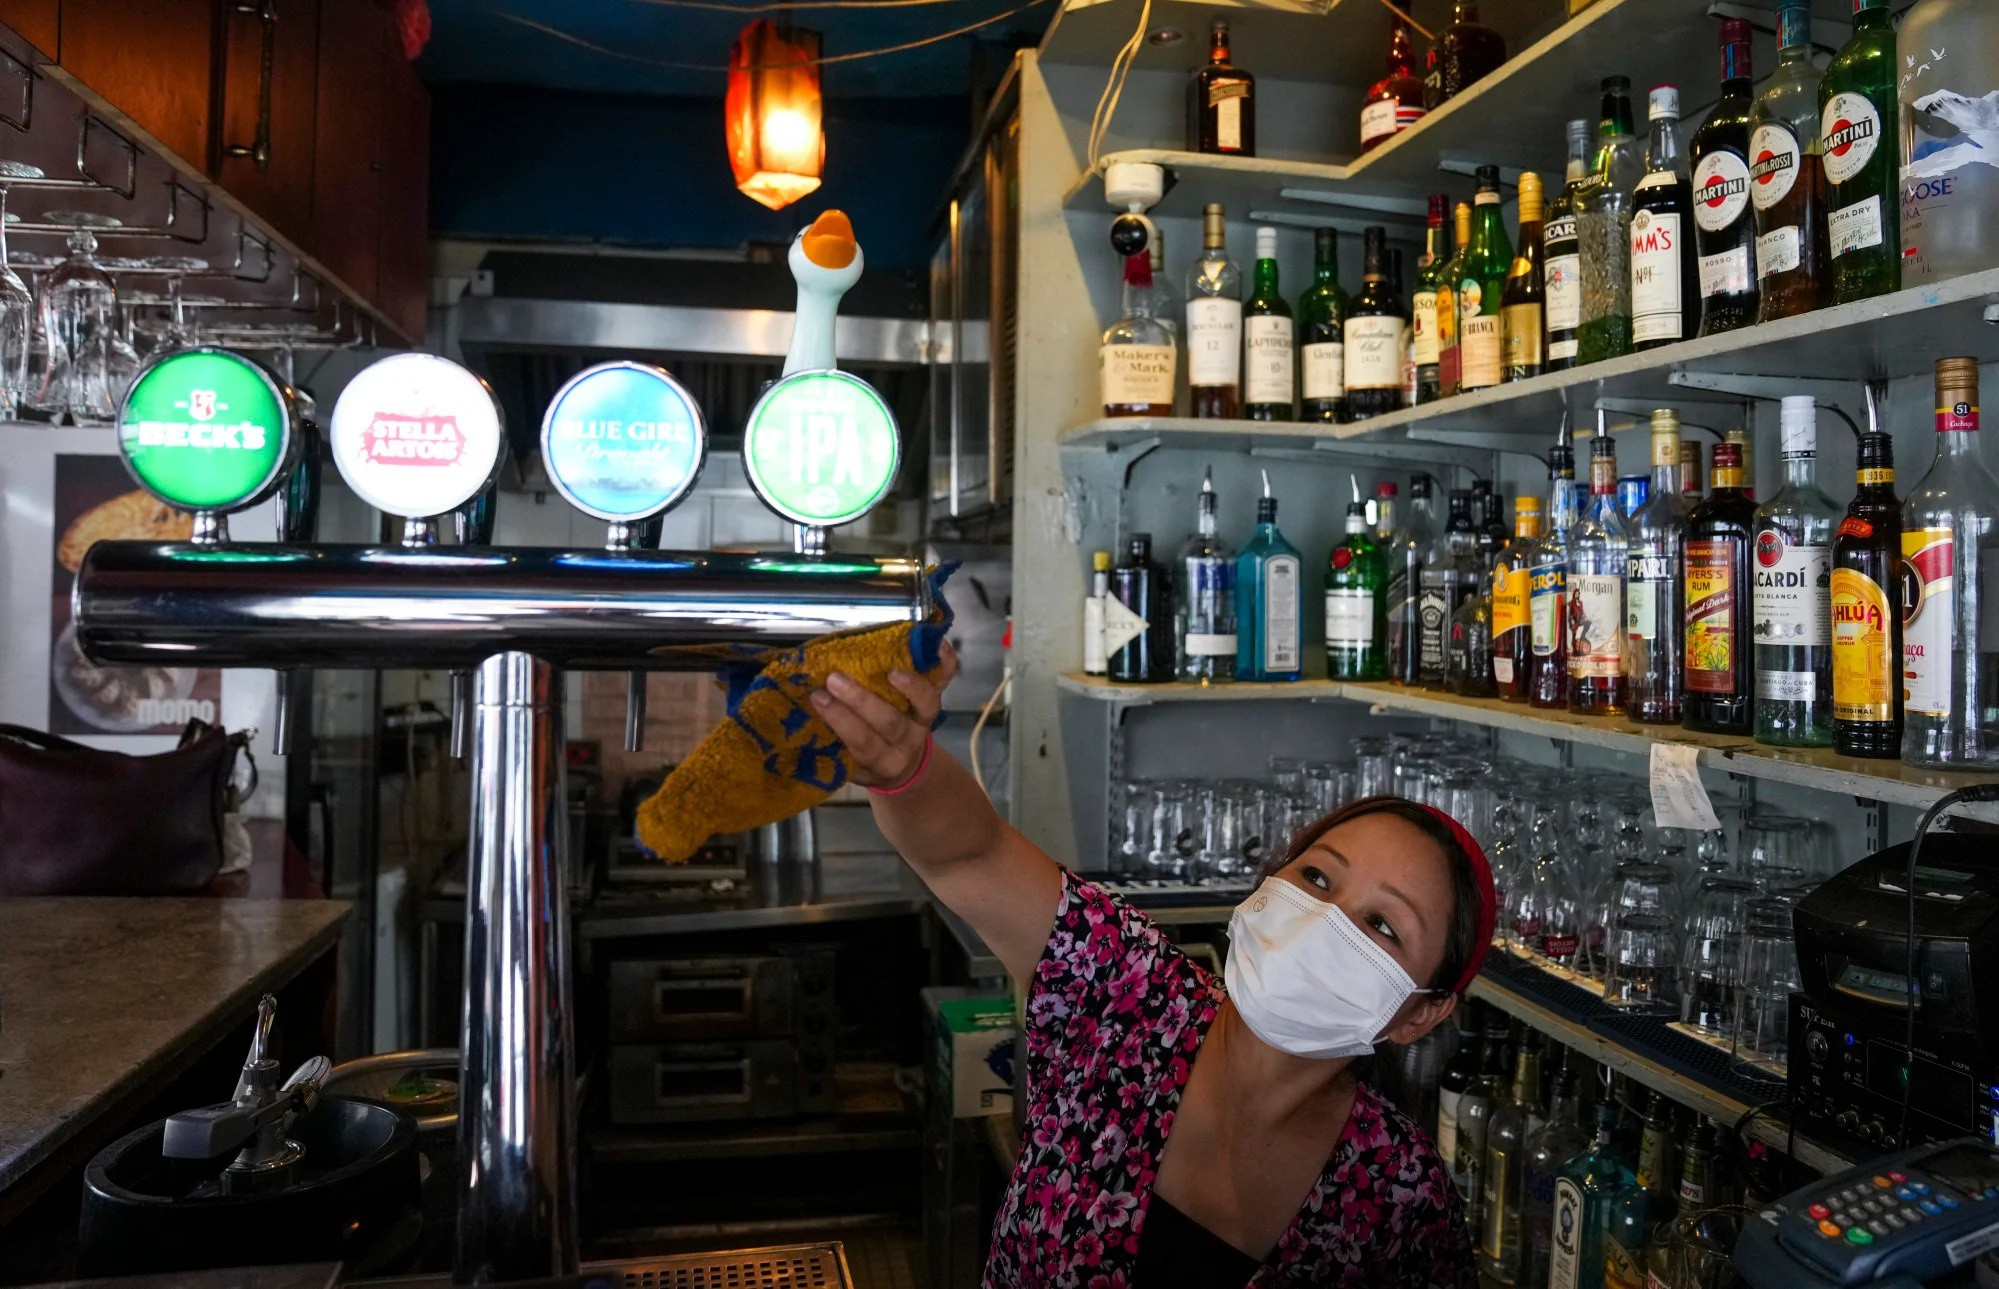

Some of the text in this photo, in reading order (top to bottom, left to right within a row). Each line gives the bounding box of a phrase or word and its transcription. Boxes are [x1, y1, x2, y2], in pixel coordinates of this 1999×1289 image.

[1824, 120, 1872, 152] MARTINI
[1696, 179, 1743, 203] MARTINI
[1830, 206, 1871, 226] EXTRA DRY
[1545, 223, 1576, 241] ICAR
[1705, 257, 1731, 267] ROSSO
[1207, 340, 1219, 350] 12
[1114, 351, 1170, 360] Maker's
[1956, 404, 1968, 414] 51
[139, 420, 266, 449] BECK'S
[372, 420, 457, 442] STELLA
[560, 420, 622, 440] BLUE
[371, 441, 458, 459] ARTOIS
[789, 414, 861, 484] IPA
[1580, 579, 1613, 596] Morgan
[1692, 581, 1711, 591] RUM
[1706, 594, 1731, 610] Dark
[137, 697, 215, 725] momo
